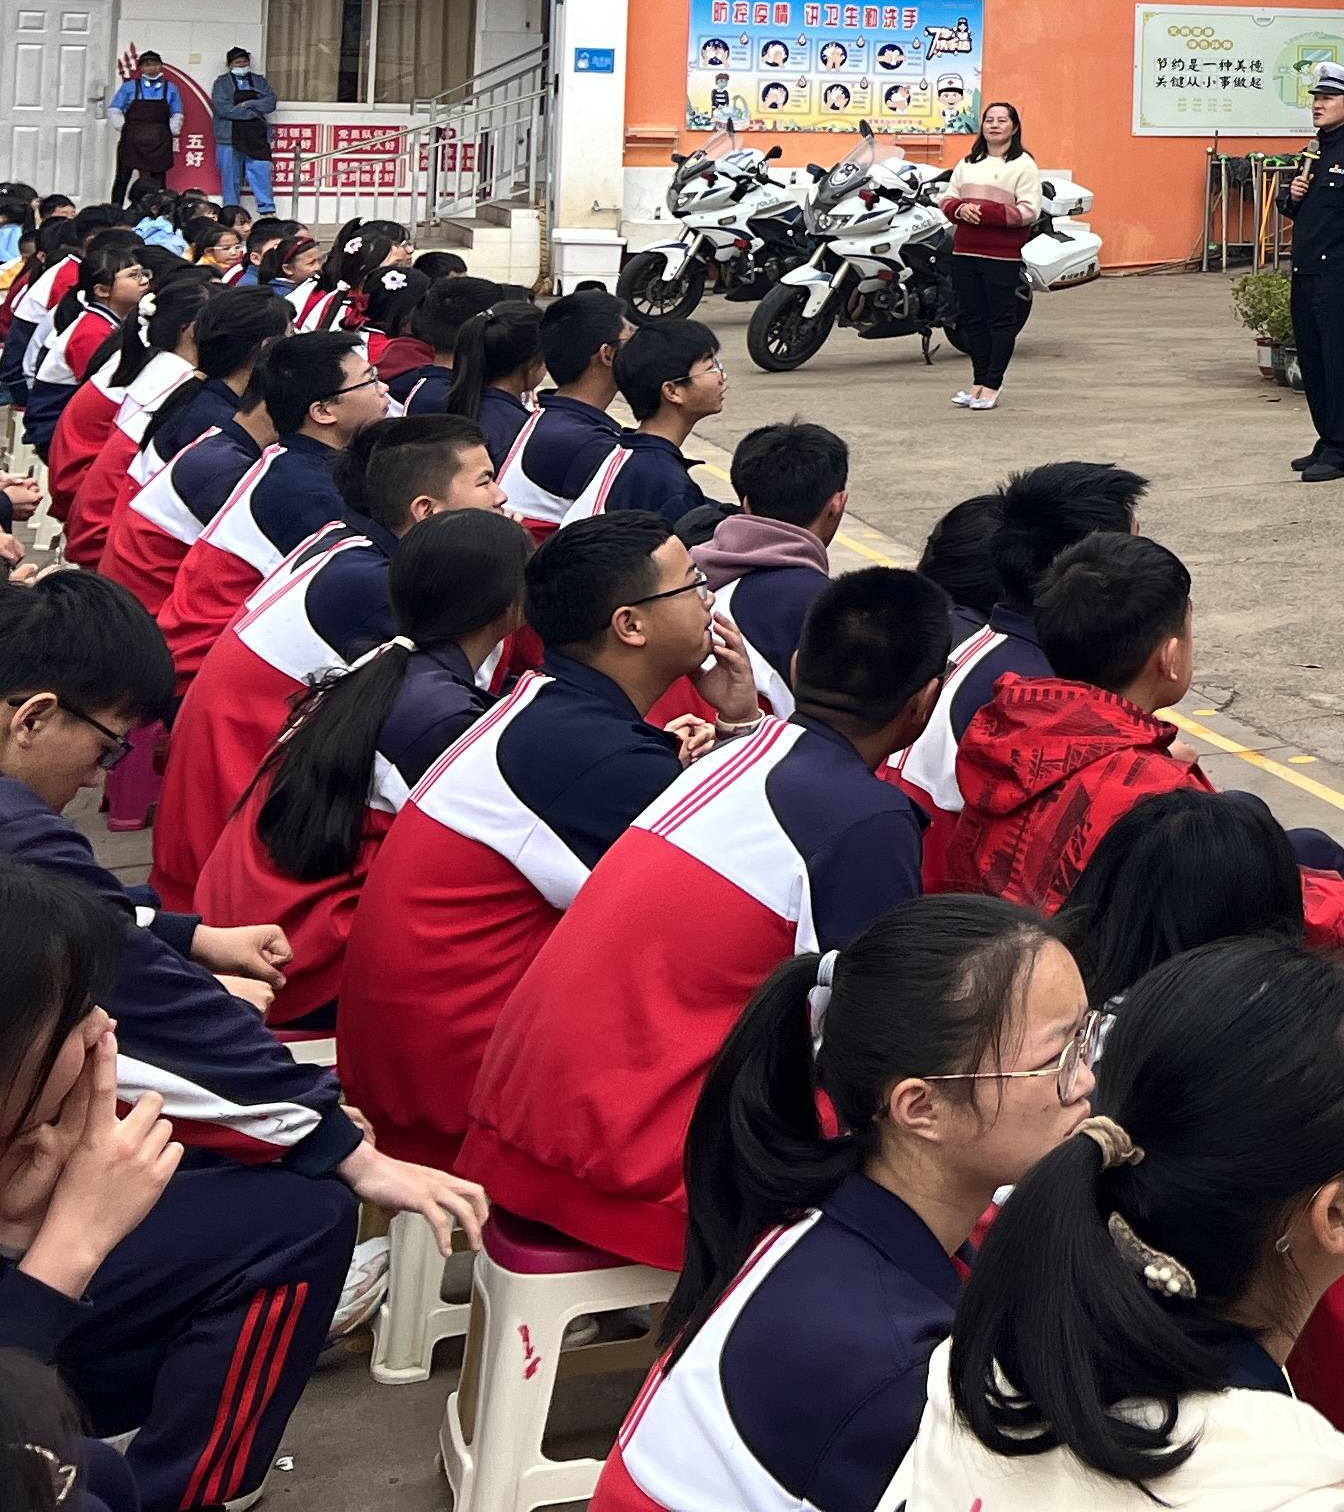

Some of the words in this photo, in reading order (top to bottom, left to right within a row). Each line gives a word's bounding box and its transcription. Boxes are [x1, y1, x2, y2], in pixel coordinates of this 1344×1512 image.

[712, 1, 791, 26] 防控疫情
[1155, 57, 1264, 74] 节约是一种美德
[1155, 74, 1264, 90] 关键从小事做起
